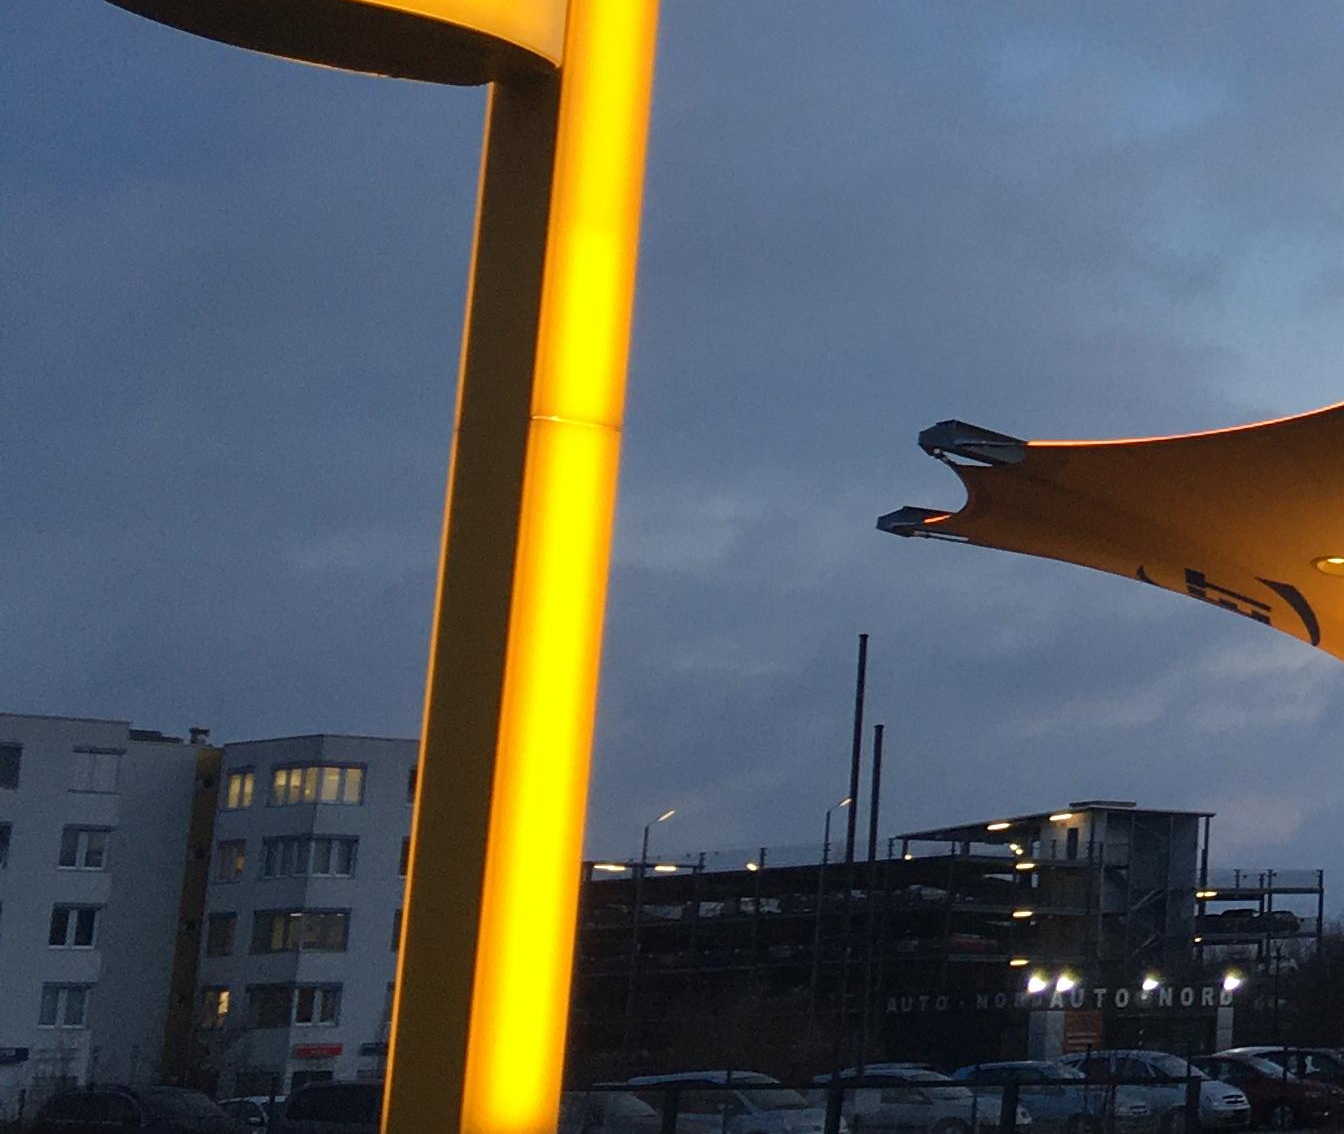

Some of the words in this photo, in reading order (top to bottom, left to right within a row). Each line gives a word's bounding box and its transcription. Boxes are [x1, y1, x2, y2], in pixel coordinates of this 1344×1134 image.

[886, 994, 949, 1012] AUTO
[1050, 986, 1130, 1009] AUTO
[1159, 986, 1233, 1006] NORD
